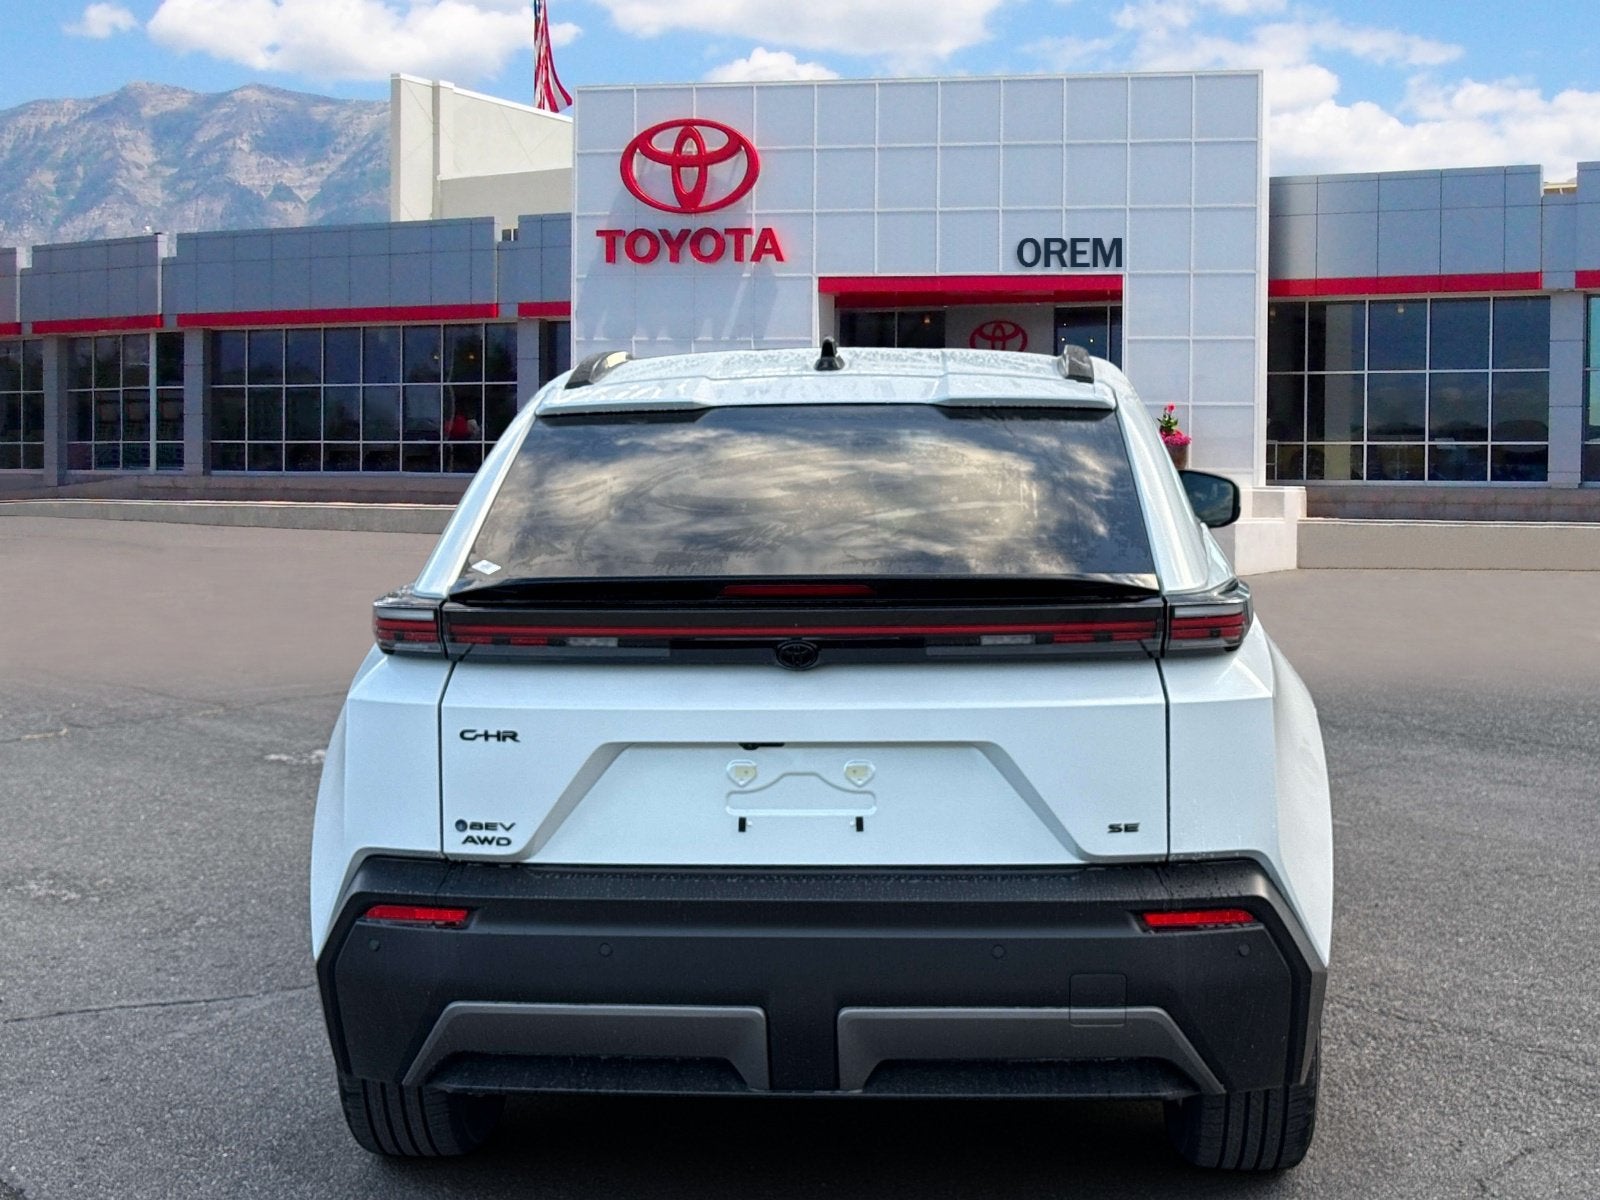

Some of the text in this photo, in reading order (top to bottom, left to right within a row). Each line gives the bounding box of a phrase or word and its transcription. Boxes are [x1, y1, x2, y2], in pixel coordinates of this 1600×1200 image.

[596, 227, 786, 264] TOYOTA
[1016, 237, 1123, 269] OREM
[469, 822, 516, 831] BEV
[1107, 823, 1140, 834] SE
[462, 836, 512, 846] AWD
